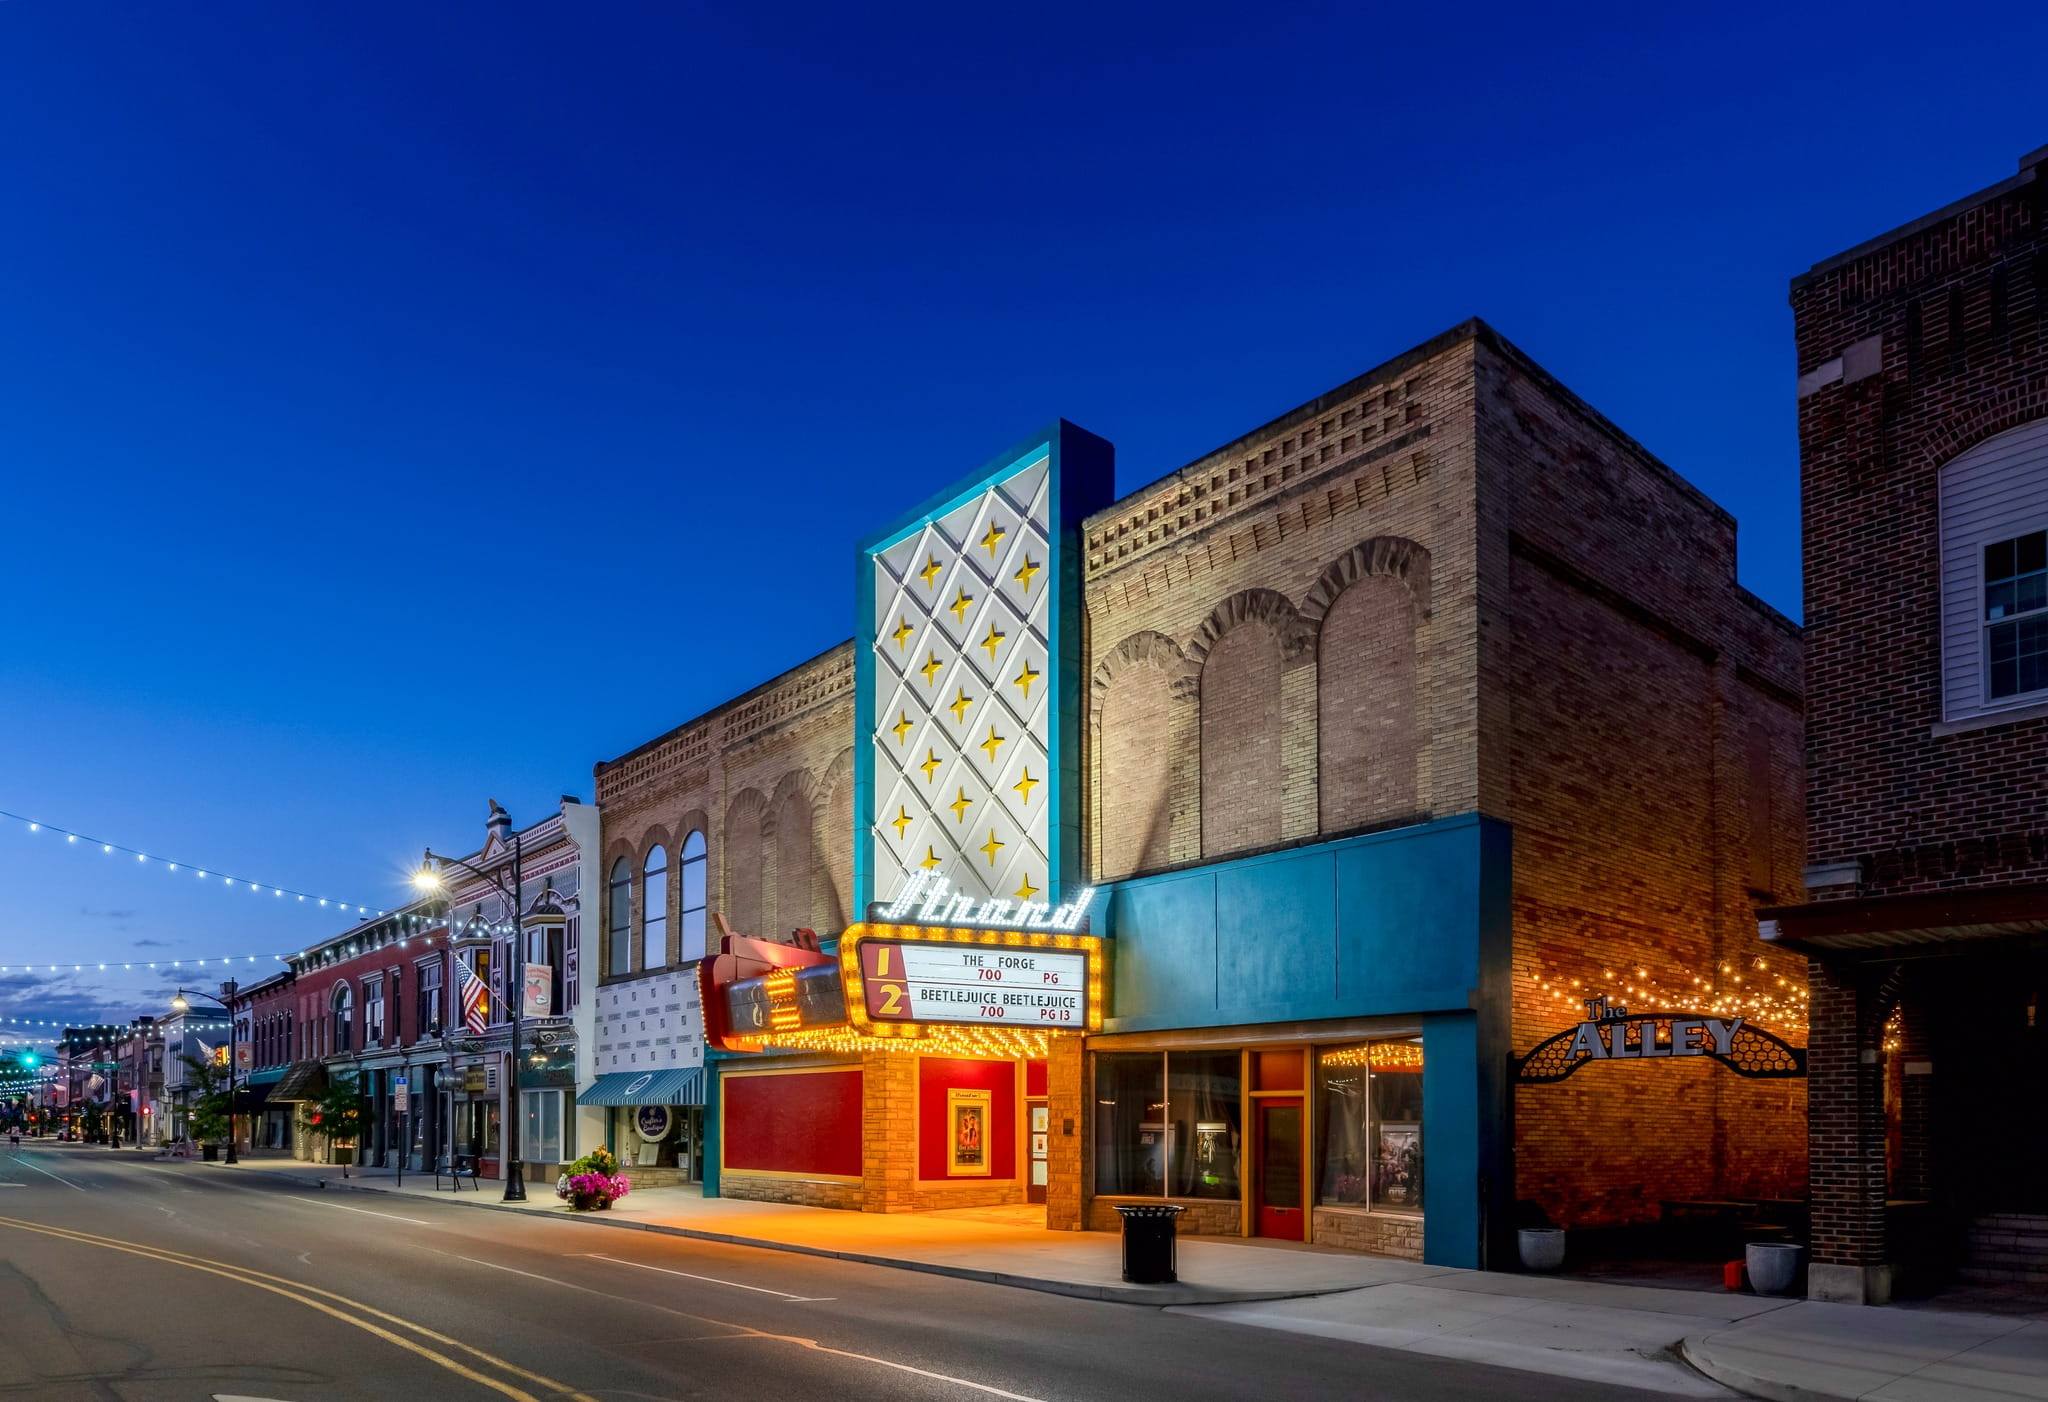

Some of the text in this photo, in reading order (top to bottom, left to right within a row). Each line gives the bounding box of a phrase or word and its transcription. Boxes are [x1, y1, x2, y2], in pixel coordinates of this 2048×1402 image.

[877, 869, 1097, 930] Strand
[877, 947, 890, 977] 1
[963, 954, 1036, 970] THE FORGE
[977, 969, 1059, 984] 700 PG
[878, 984, 903, 1015] 2
[921, 989, 1076, 1008] BEETLEJUICE BEETLEJUICE
[1584, 996, 1627, 1020] The
[980, 1006, 1005, 1018] 700
[1565, 1017, 1746, 1060] ALLEY
